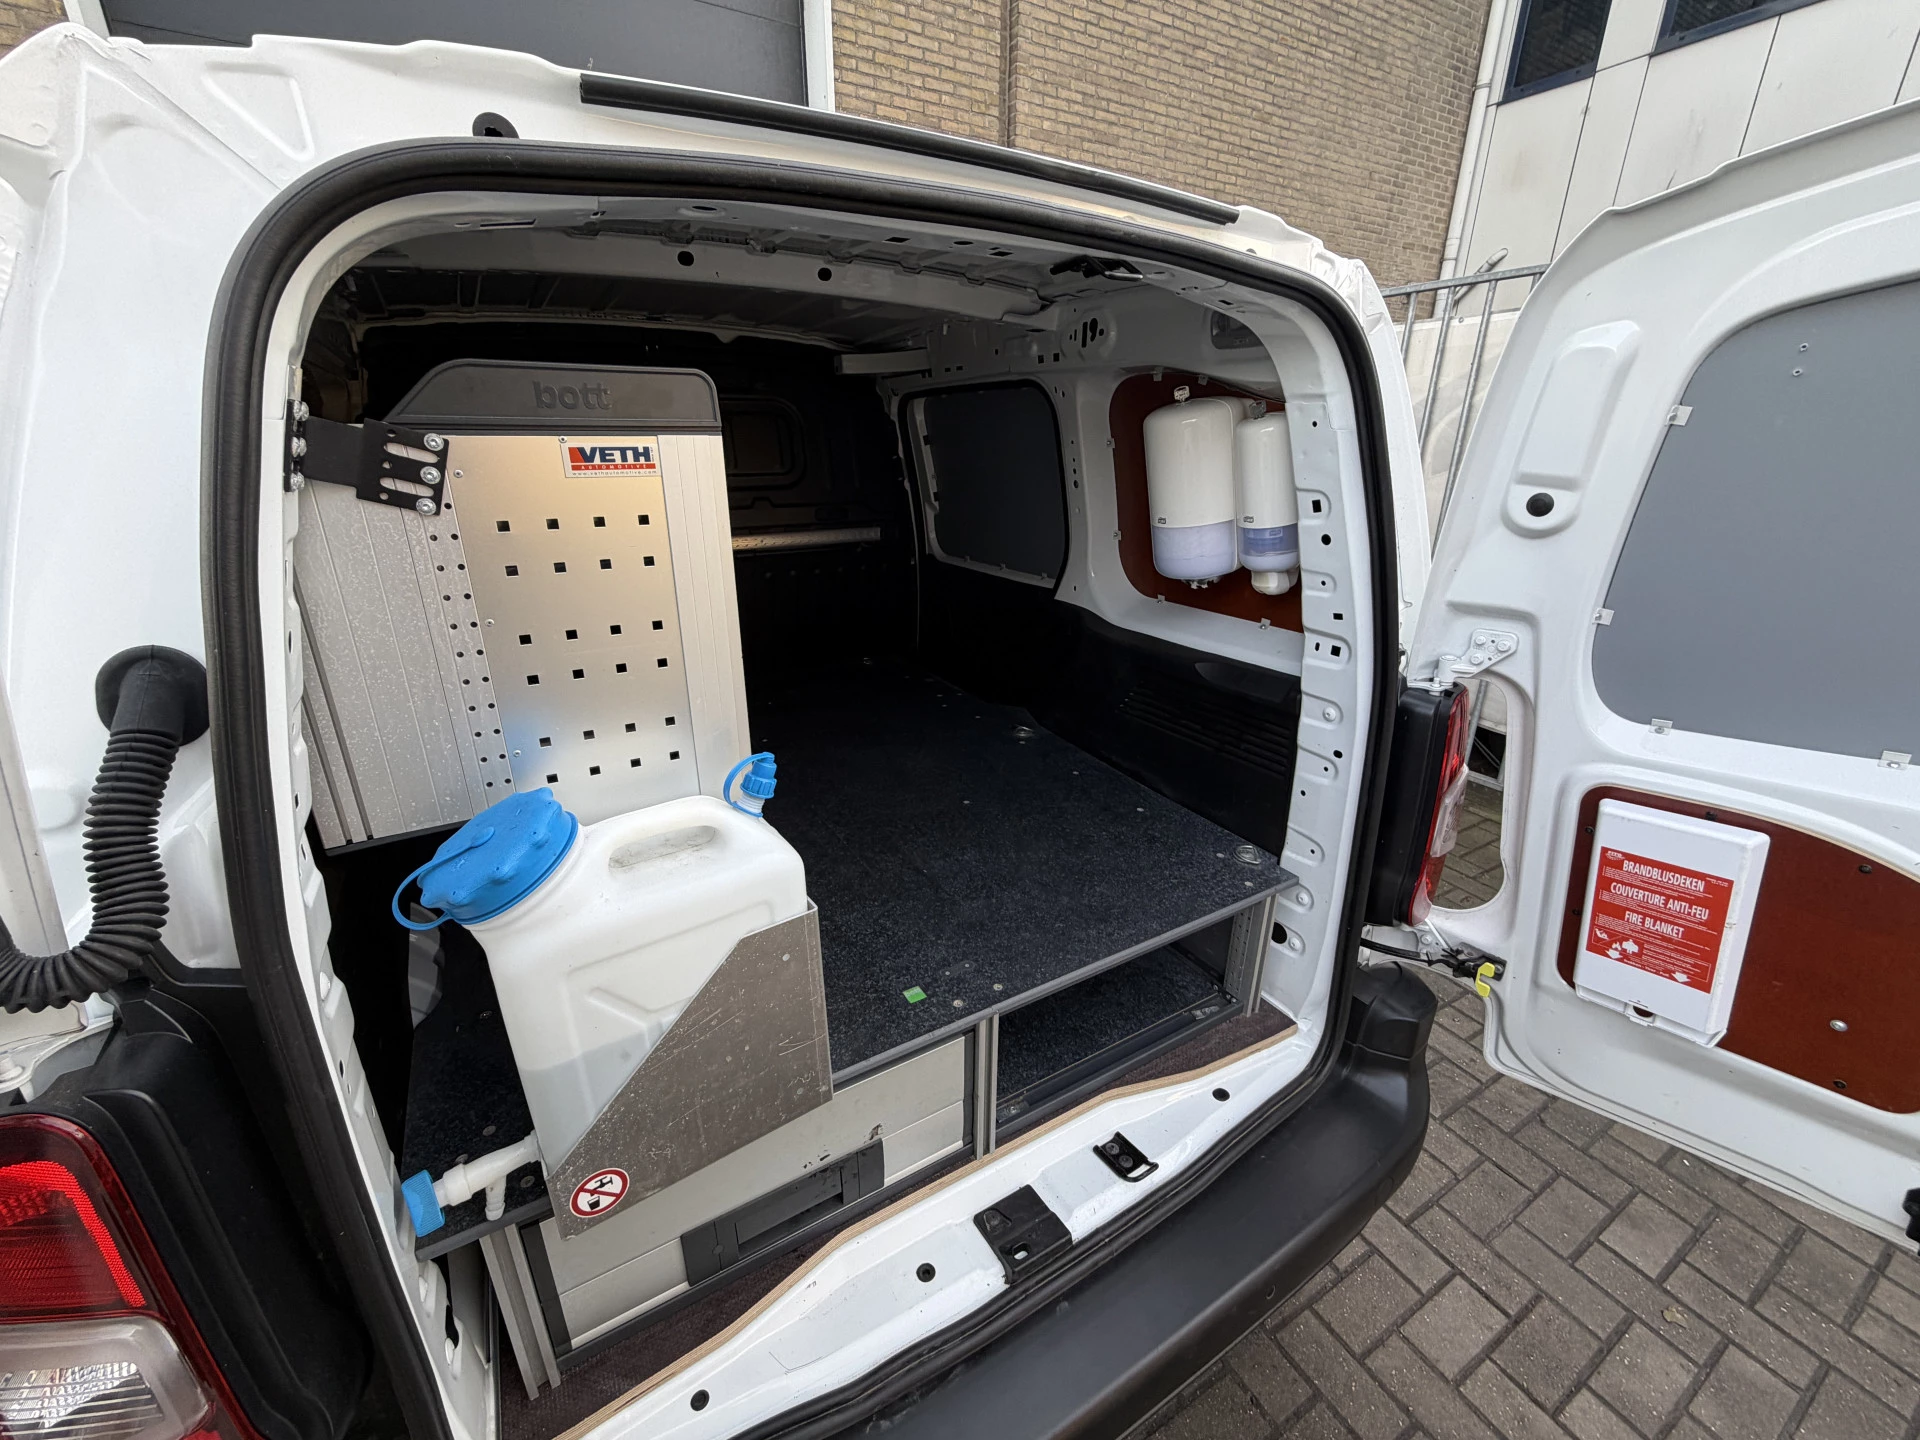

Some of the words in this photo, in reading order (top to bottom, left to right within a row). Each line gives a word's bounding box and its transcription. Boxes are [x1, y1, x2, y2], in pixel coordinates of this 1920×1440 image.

[532, 381, 612, 410] bott
[576, 446, 651, 463] VETH
[1622, 860, 1706, 892] BRANDBLUSDEKEN
[1610, 882, 1666, 908] COUVERTURE
[1666, 898, 1710, 920] ANTI-FEU
[1624, 911, 1642, 926] FIRE
[1644, 920, 1684, 938] BLANKET
